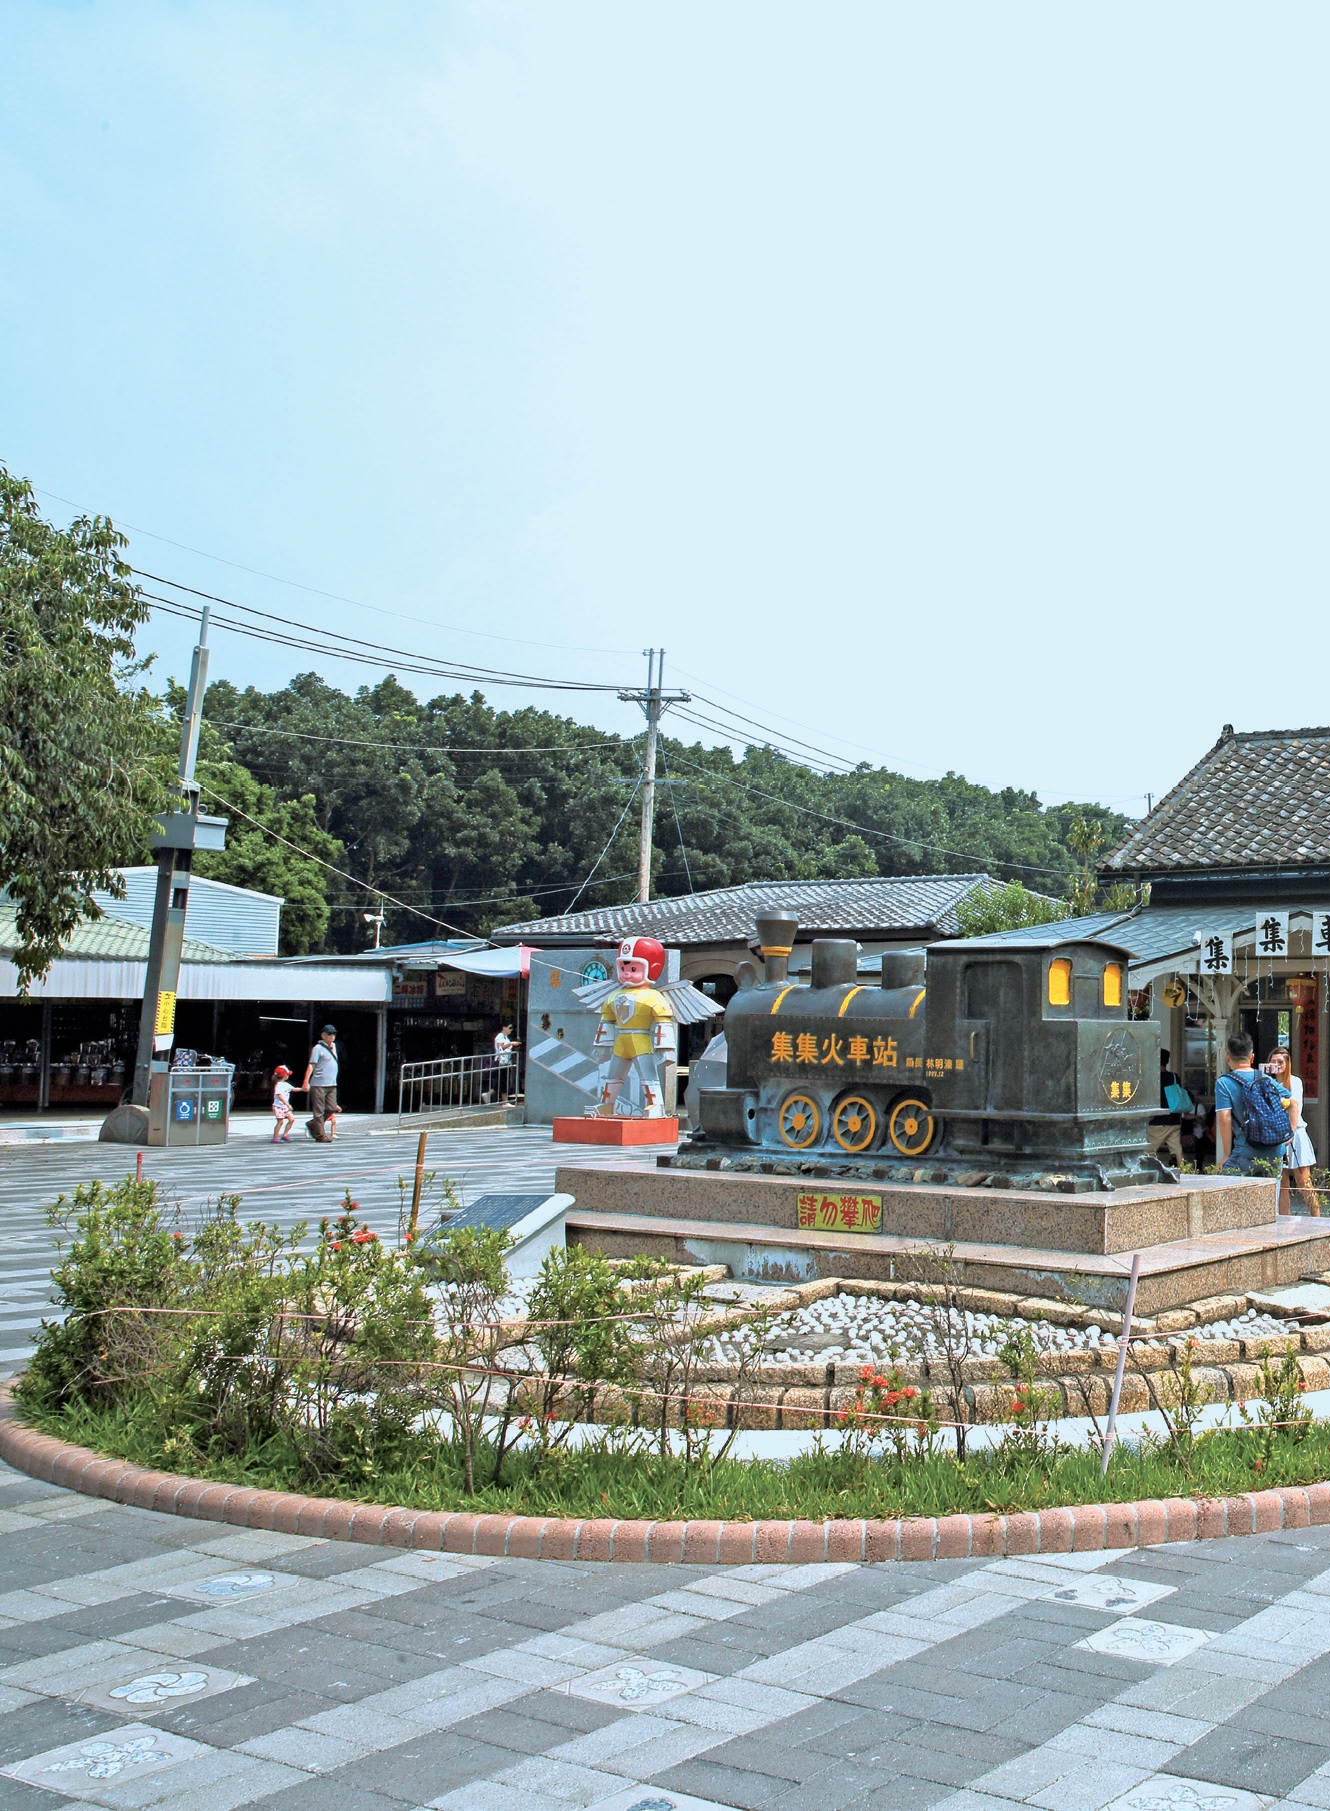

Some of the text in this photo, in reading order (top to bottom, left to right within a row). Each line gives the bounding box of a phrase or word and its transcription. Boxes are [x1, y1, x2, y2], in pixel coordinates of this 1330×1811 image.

[770, 1031, 898, 1067] 集集火車站
[1110, 1080, 1131, 1098] 集集
[799, 1195, 881, 1229] 請勿攀爬
